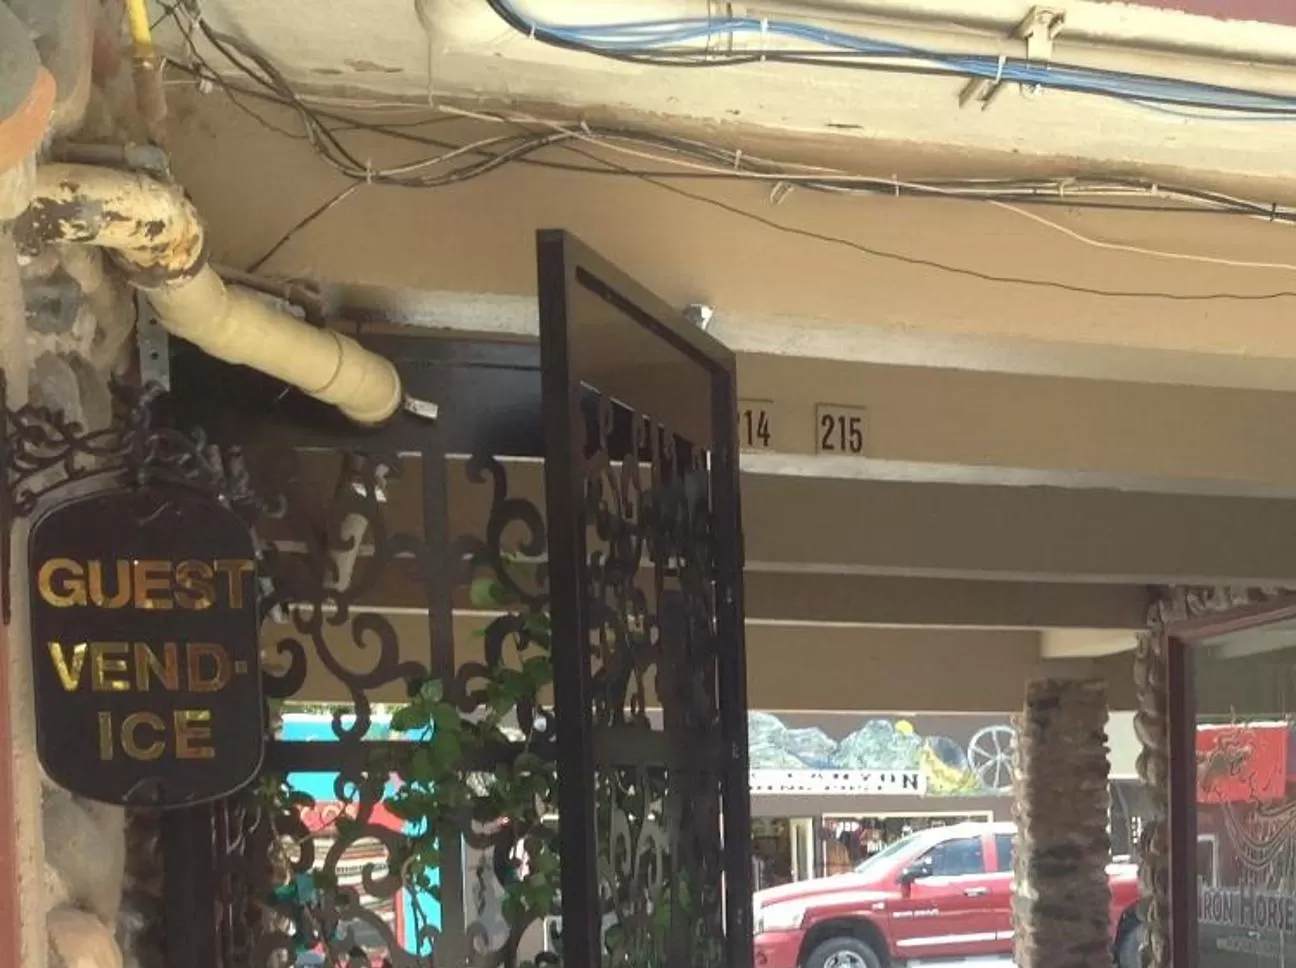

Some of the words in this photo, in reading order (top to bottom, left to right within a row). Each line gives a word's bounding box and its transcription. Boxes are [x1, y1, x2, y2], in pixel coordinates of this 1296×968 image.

[738, 409, 772, 447] 14
[820, 413, 864, 453] 215
[37, 557, 255, 611] GUEST
[97, 708, 216, 761] ICE
